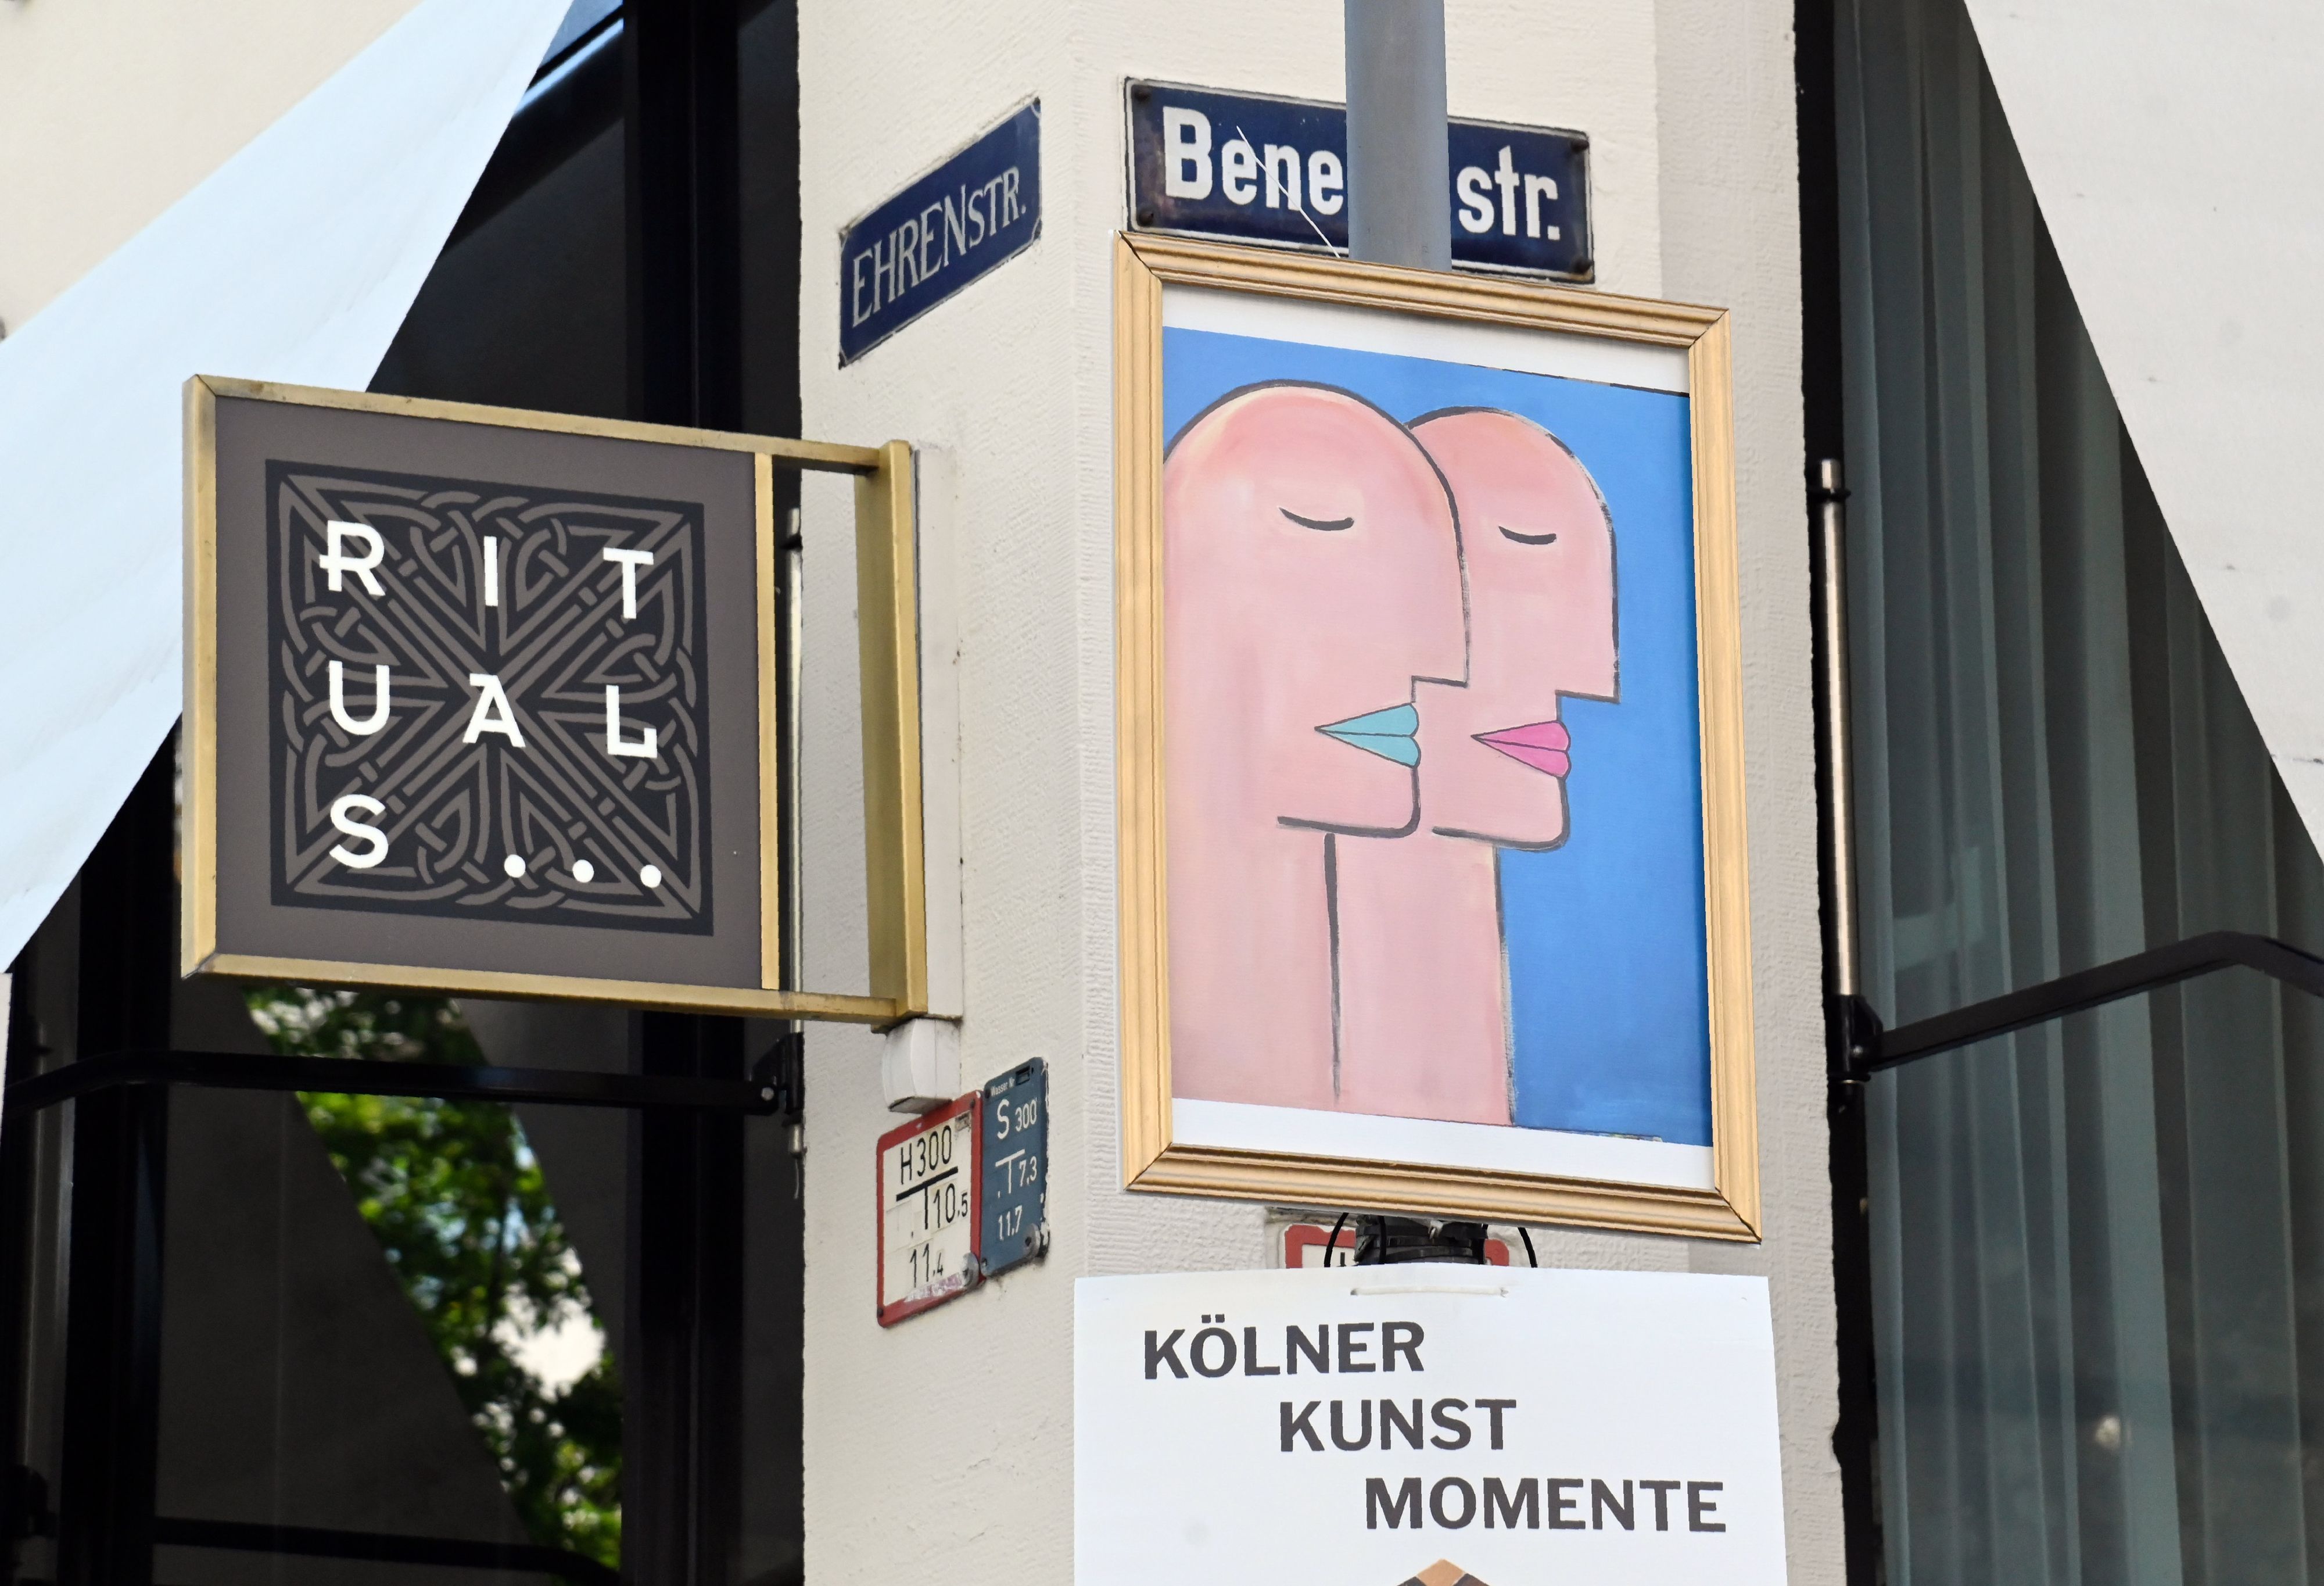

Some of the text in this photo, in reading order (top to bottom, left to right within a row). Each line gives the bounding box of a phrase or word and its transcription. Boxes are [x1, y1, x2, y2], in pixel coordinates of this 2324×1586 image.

[852, 166, 1027, 329] EHRENSTR.
[901, 1125, 952, 1185] H300
[1144, 1314, 1425, 1379] KÖLNER
[1280, 1398, 1516, 1452] KUNST
[1366, 1477, 1727, 1533] MOMENTE
